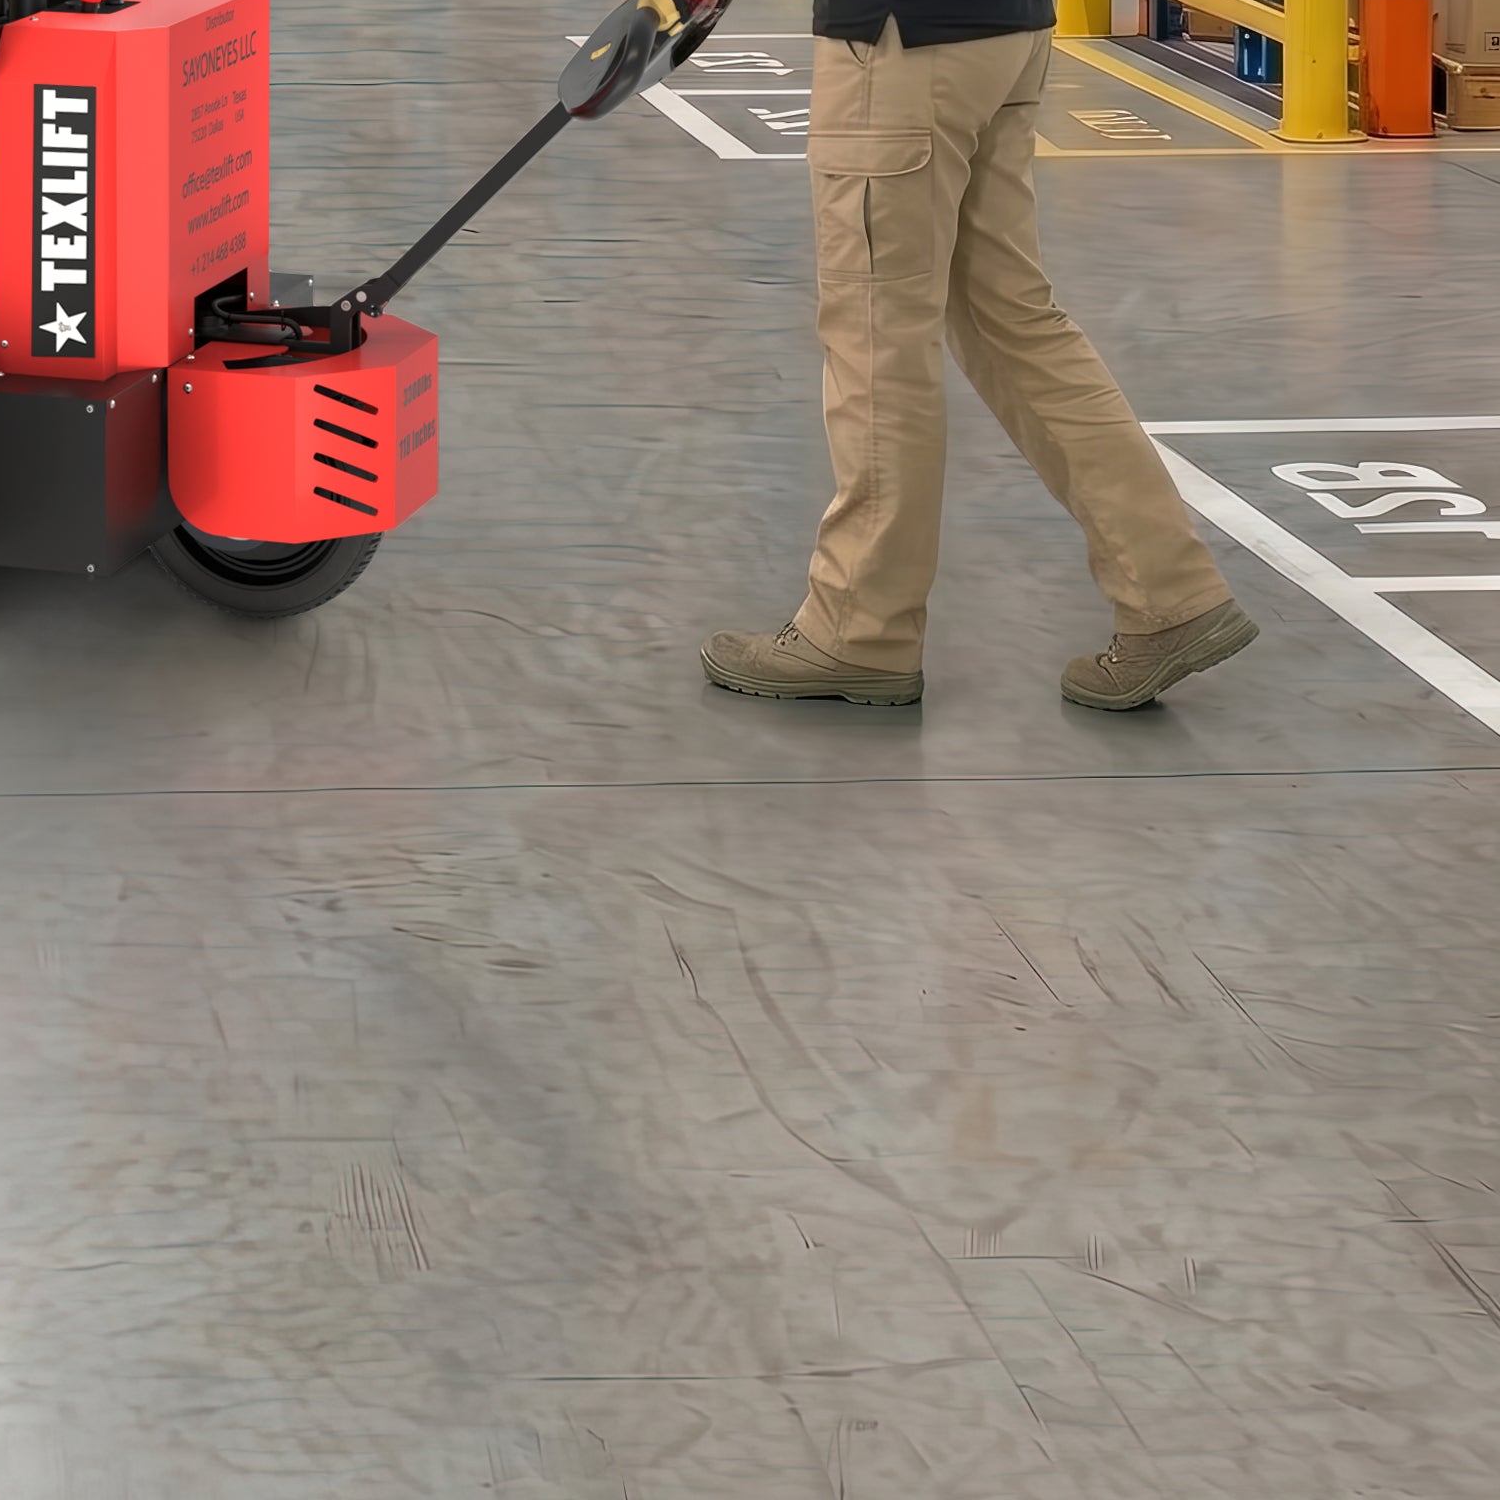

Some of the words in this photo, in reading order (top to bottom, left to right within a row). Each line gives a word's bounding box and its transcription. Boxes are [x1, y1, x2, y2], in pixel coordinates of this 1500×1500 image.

[205, 10, 234, 31] Distributor
[182, 38, 238, 87] SAYONEYES
[240, 30, 257, 61] LLC
[40, 89, 89, 293] TEXLIFT
[182, 150, 253, 199] office@texliftcom
